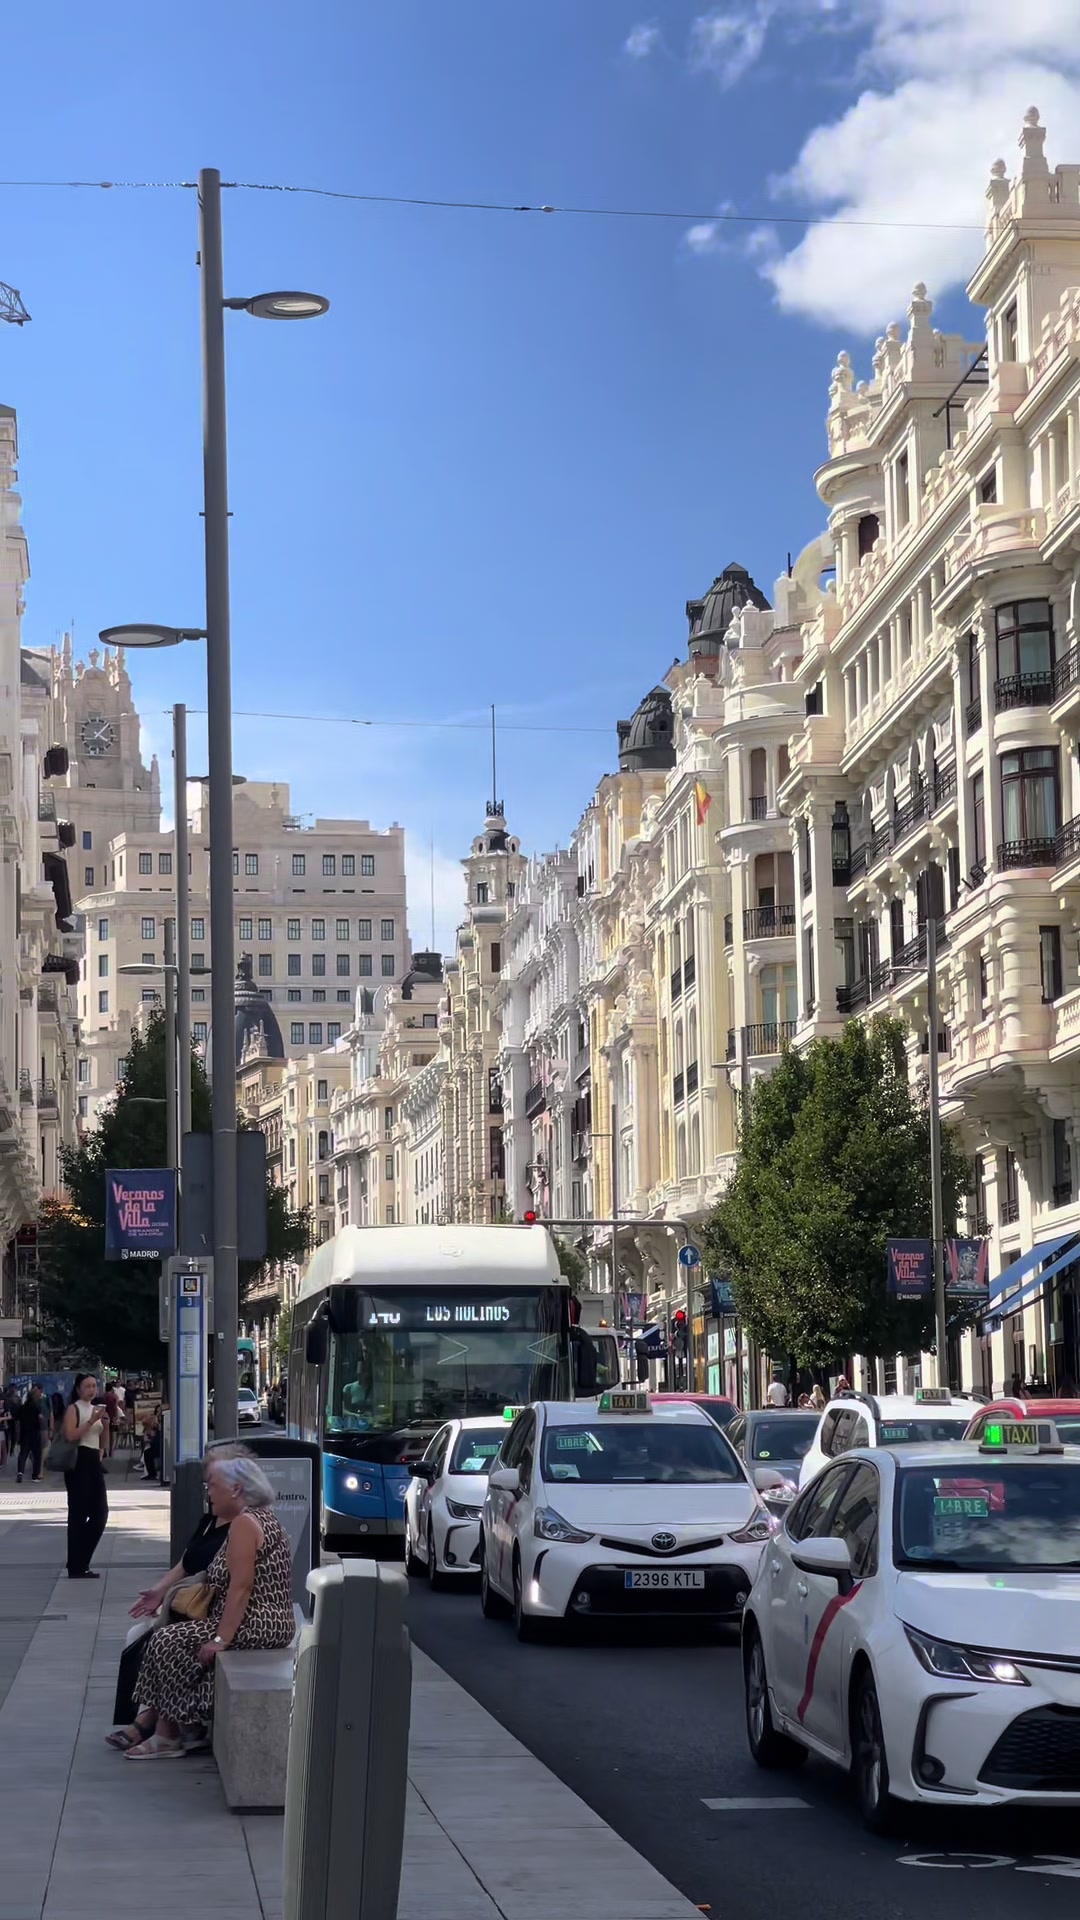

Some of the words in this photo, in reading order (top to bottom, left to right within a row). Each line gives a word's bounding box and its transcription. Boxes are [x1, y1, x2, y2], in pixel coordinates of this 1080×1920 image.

[112, 1180, 164, 1203] Veranos
[125, 1200, 140, 1211] de
[142, 1200, 156, 1212] la
[119, 1210, 150, 1230] Villa
[130, 1250, 159, 1258] MADRID
[891, 1248, 924, 1262] Veranos
[895, 1266, 916, 1280] Villa
[613, 1395, 635, 1408] TAXI
[559, 1437, 585, 1447] LIBRE
[1003, 1426, 1035, 1444] TAXI
[940, 1500, 981, 1513] LIBRE
[633, 1573, 669, 1586] 2396
[674, 1572, 701, 1586] KTL
